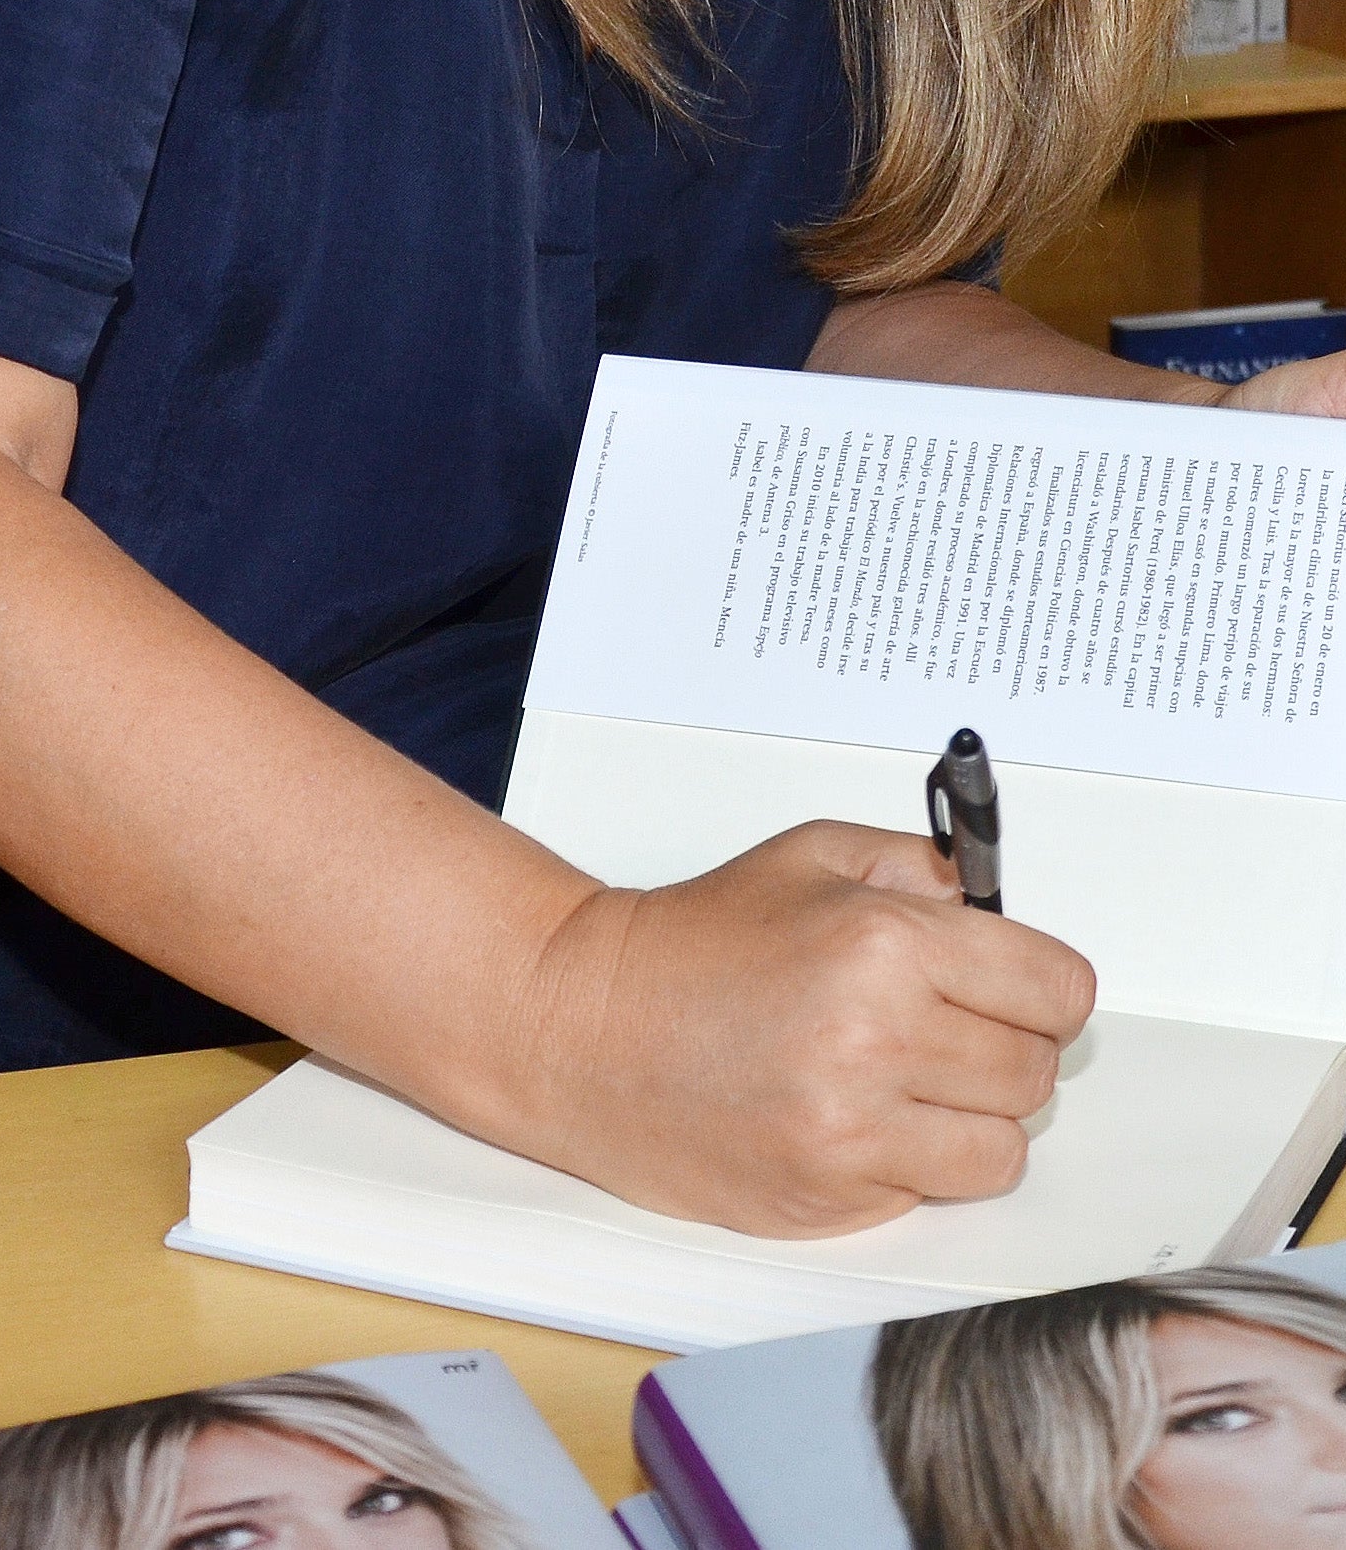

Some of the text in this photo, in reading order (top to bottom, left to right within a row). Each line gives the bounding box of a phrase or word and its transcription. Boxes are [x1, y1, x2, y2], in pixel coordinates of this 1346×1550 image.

[1033, 449, 1090, 696] licenciatura en Ciencias Políticas en 1987.
[1213, 463, 1264, 719] padres comenzó un largo periplo de viajes
[1240, 465, 1289, 701] Cecilia y Luis. Tras la separación de sus
[1327, 568, 1341, 602] nació
[1261, 467, 1312, 718] Loreto. Es la mayor de sus dos hermanos:
[1284, 469, 1336, 724] la madrileña clínica de Nuestra Señora de
[1323, 604, 1335, 621] un
[1318, 643, 1332, 659] de
[1321, 624, 1334, 641] 20
[1312, 661, 1326, 698] enero
[1309, 700, 1320, 716] en
